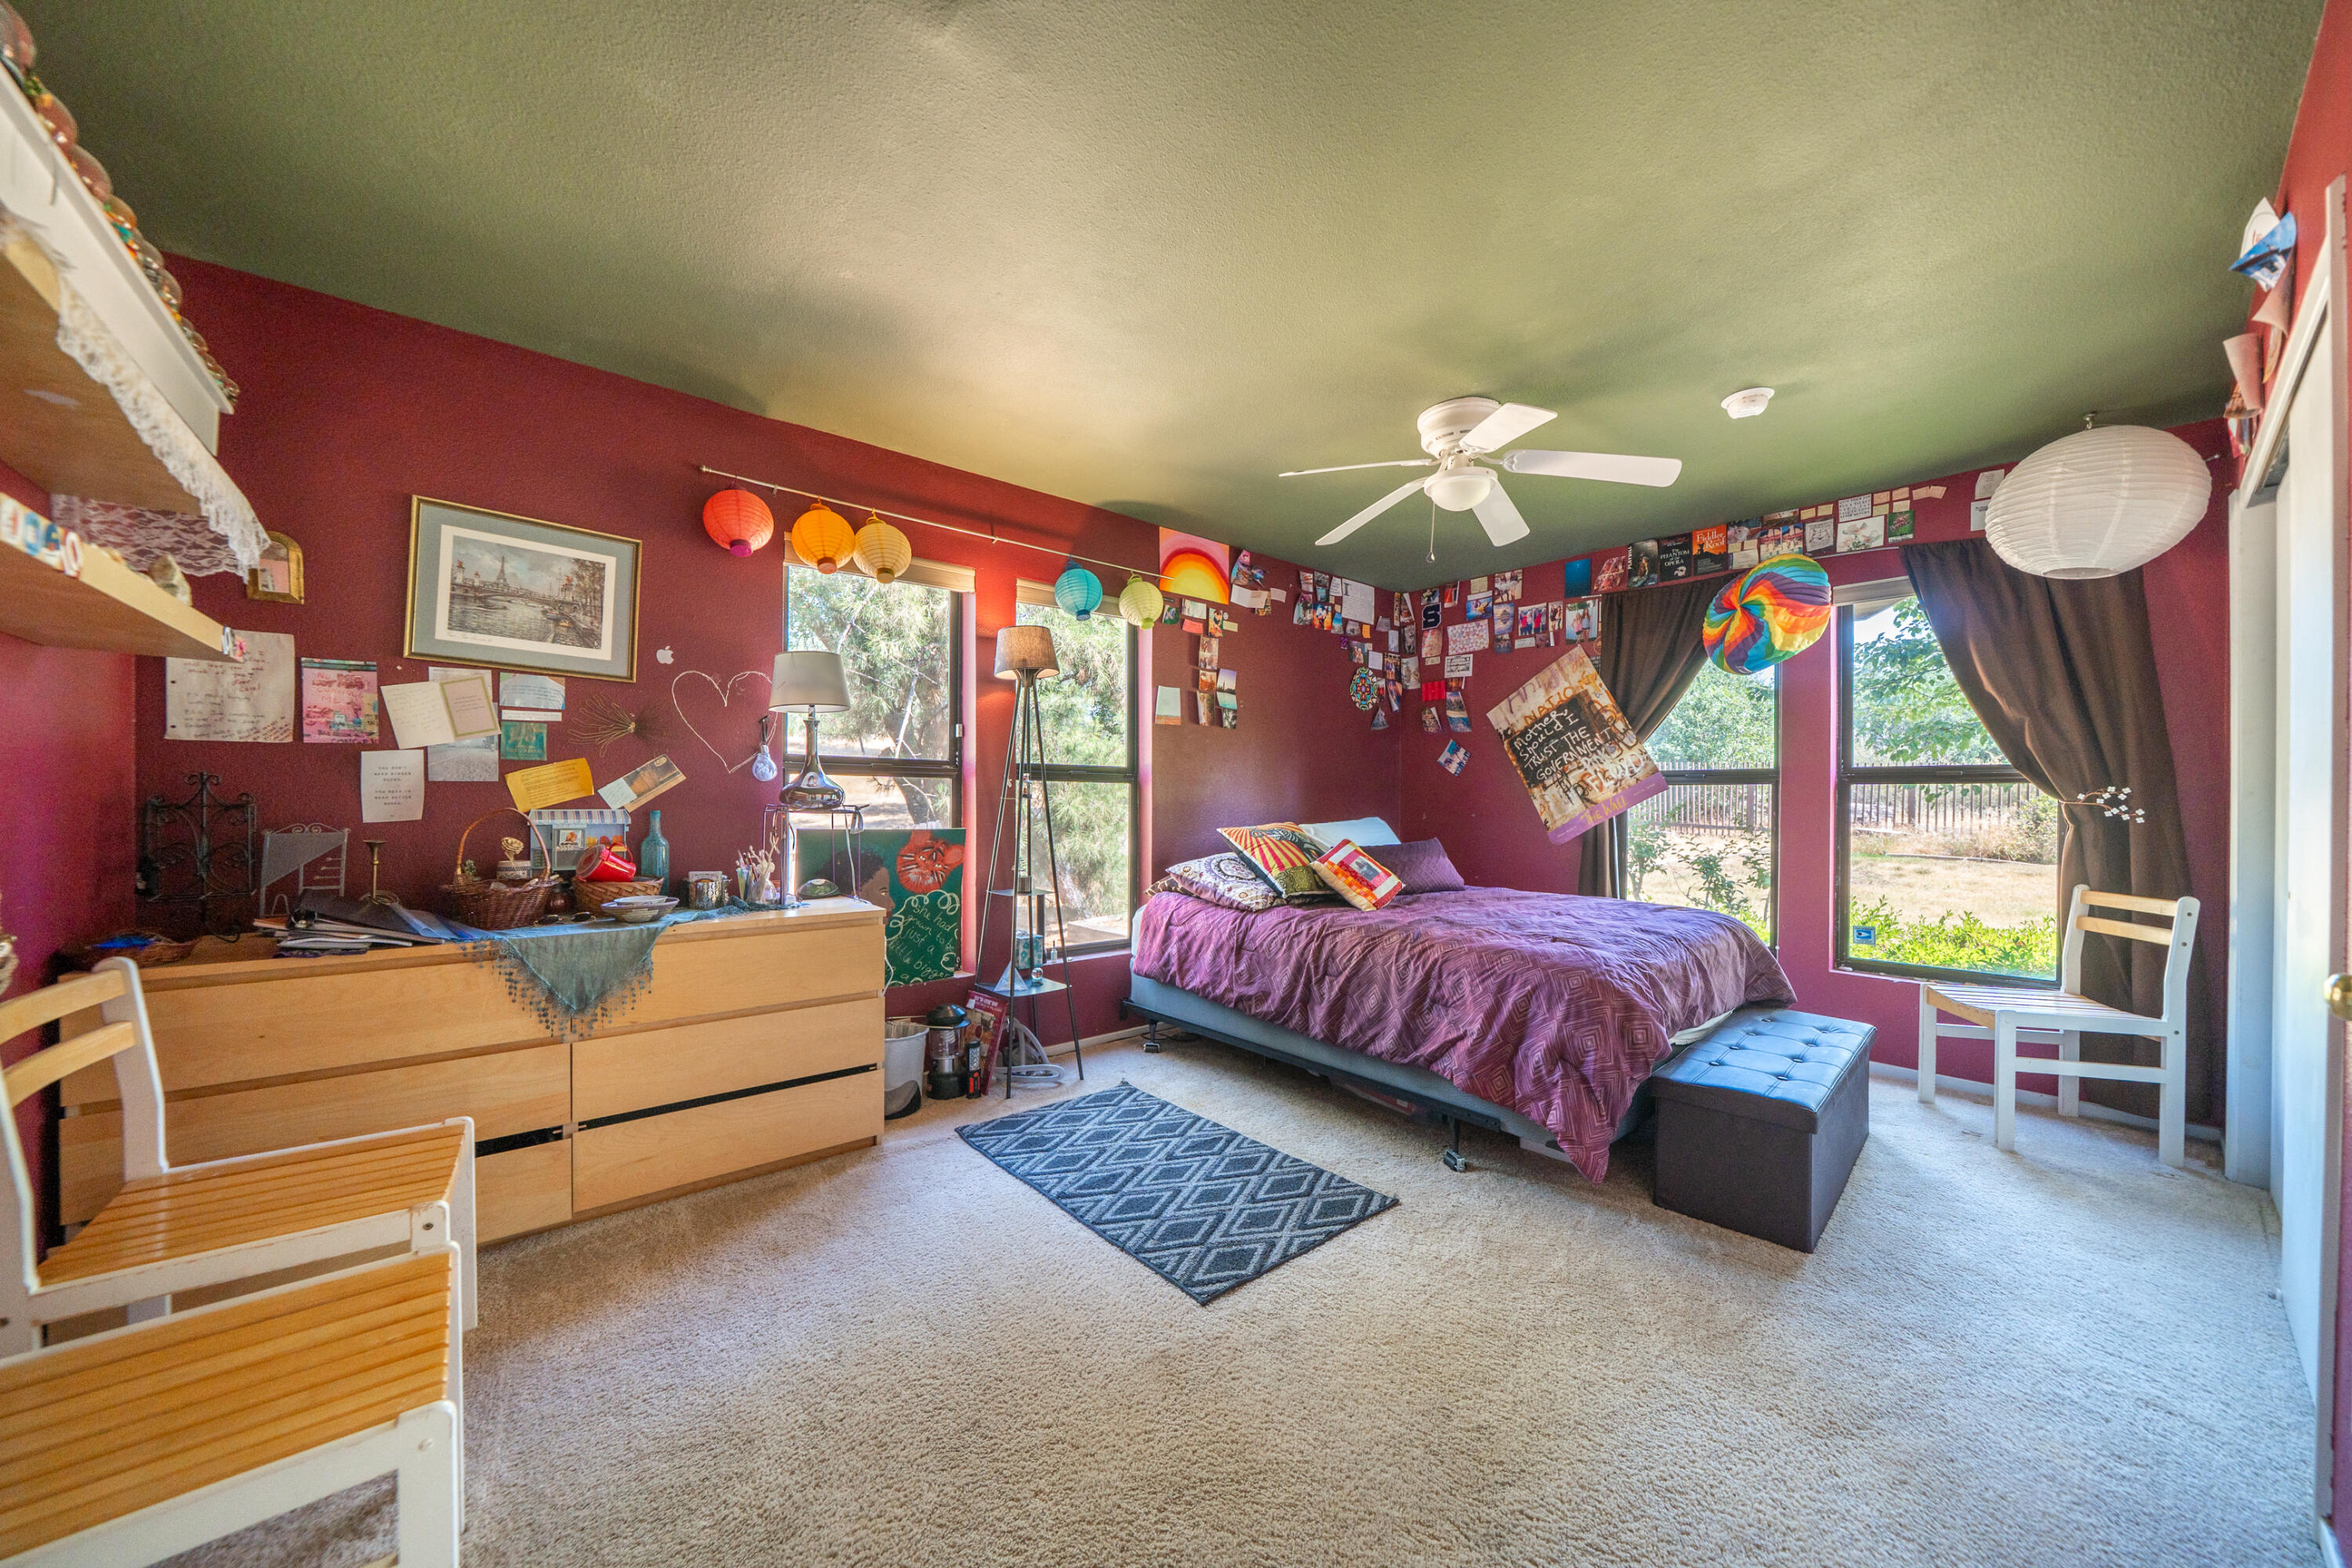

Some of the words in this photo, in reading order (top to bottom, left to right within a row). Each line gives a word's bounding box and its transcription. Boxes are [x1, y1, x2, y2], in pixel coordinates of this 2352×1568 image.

[1697, 531, 1724, 542] Fiddler
[1705, 537, 1726, 549] Roof
[1661, 550, 1690, 560] PHANTOM
[1421, 602, 1442, 630] S
[1566, 713, 1580, 726] I
[1524, 739, 1559, 771] TRUST
[1560, 726, 1590, 748] THE
[1536, 727, 1611, 781] GOVERNMENT
[1580, 810, 1603, 826] THE
[1602, 795, 1630, 816] WALL
[902, 914, 931, 935] grown
[934, 912, 957, 931] had
[898, 926, 927, 947] just
[927, 945, 935, 955] a
[888, 939, 913, 964] little
[913, 956, 950, 979] bigger
